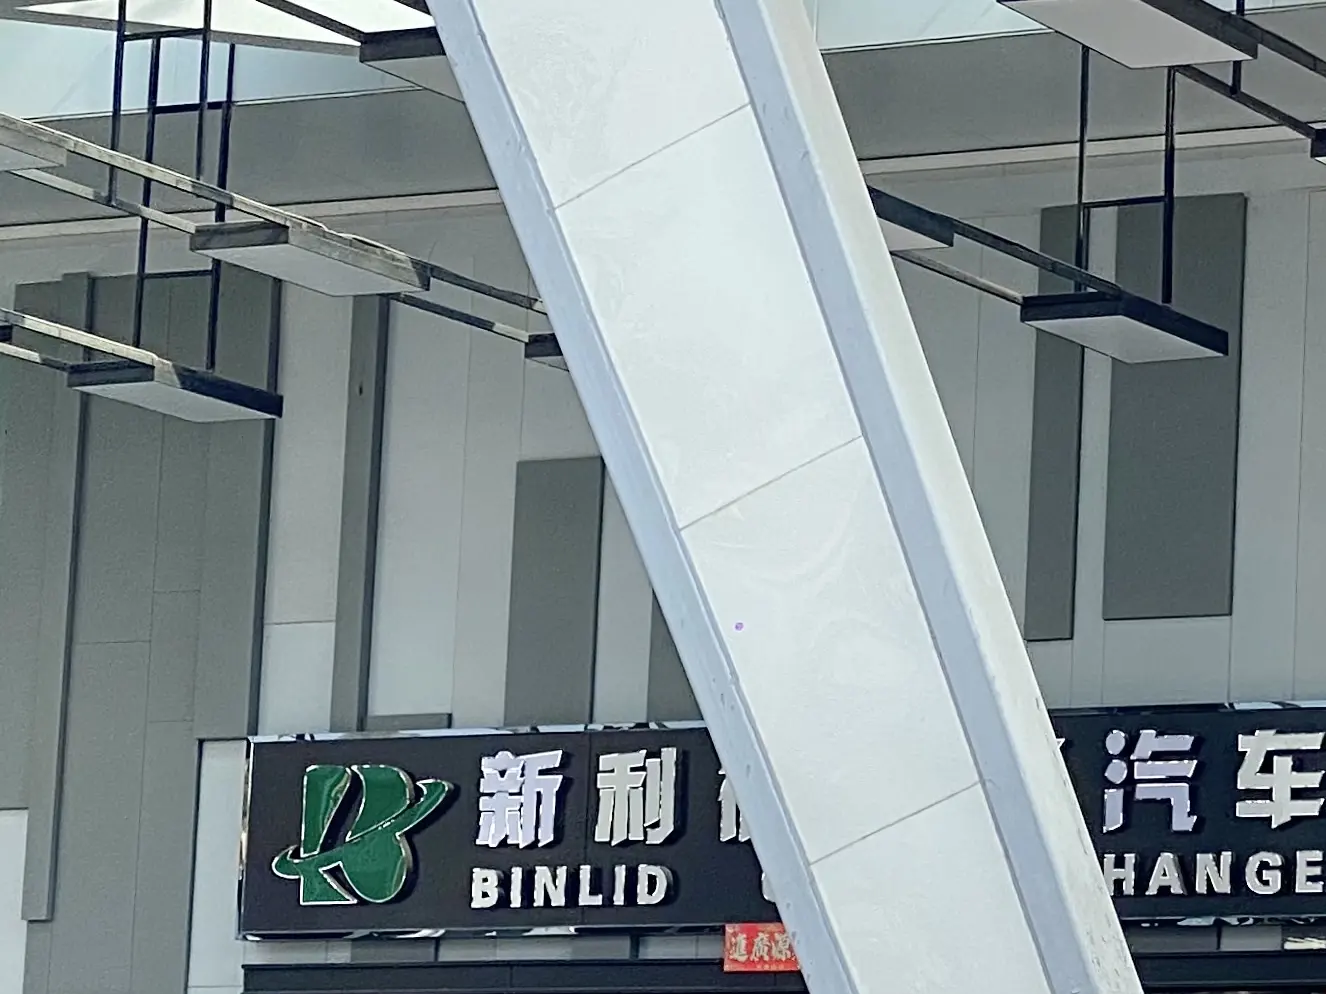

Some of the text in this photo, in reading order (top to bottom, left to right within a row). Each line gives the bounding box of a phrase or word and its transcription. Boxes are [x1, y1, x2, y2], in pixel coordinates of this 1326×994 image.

[1103, 729, 1326, 832] 汽车
[470, 864, 669, 908] BINLID
[1103, 849, 1326, 896] HANGE
